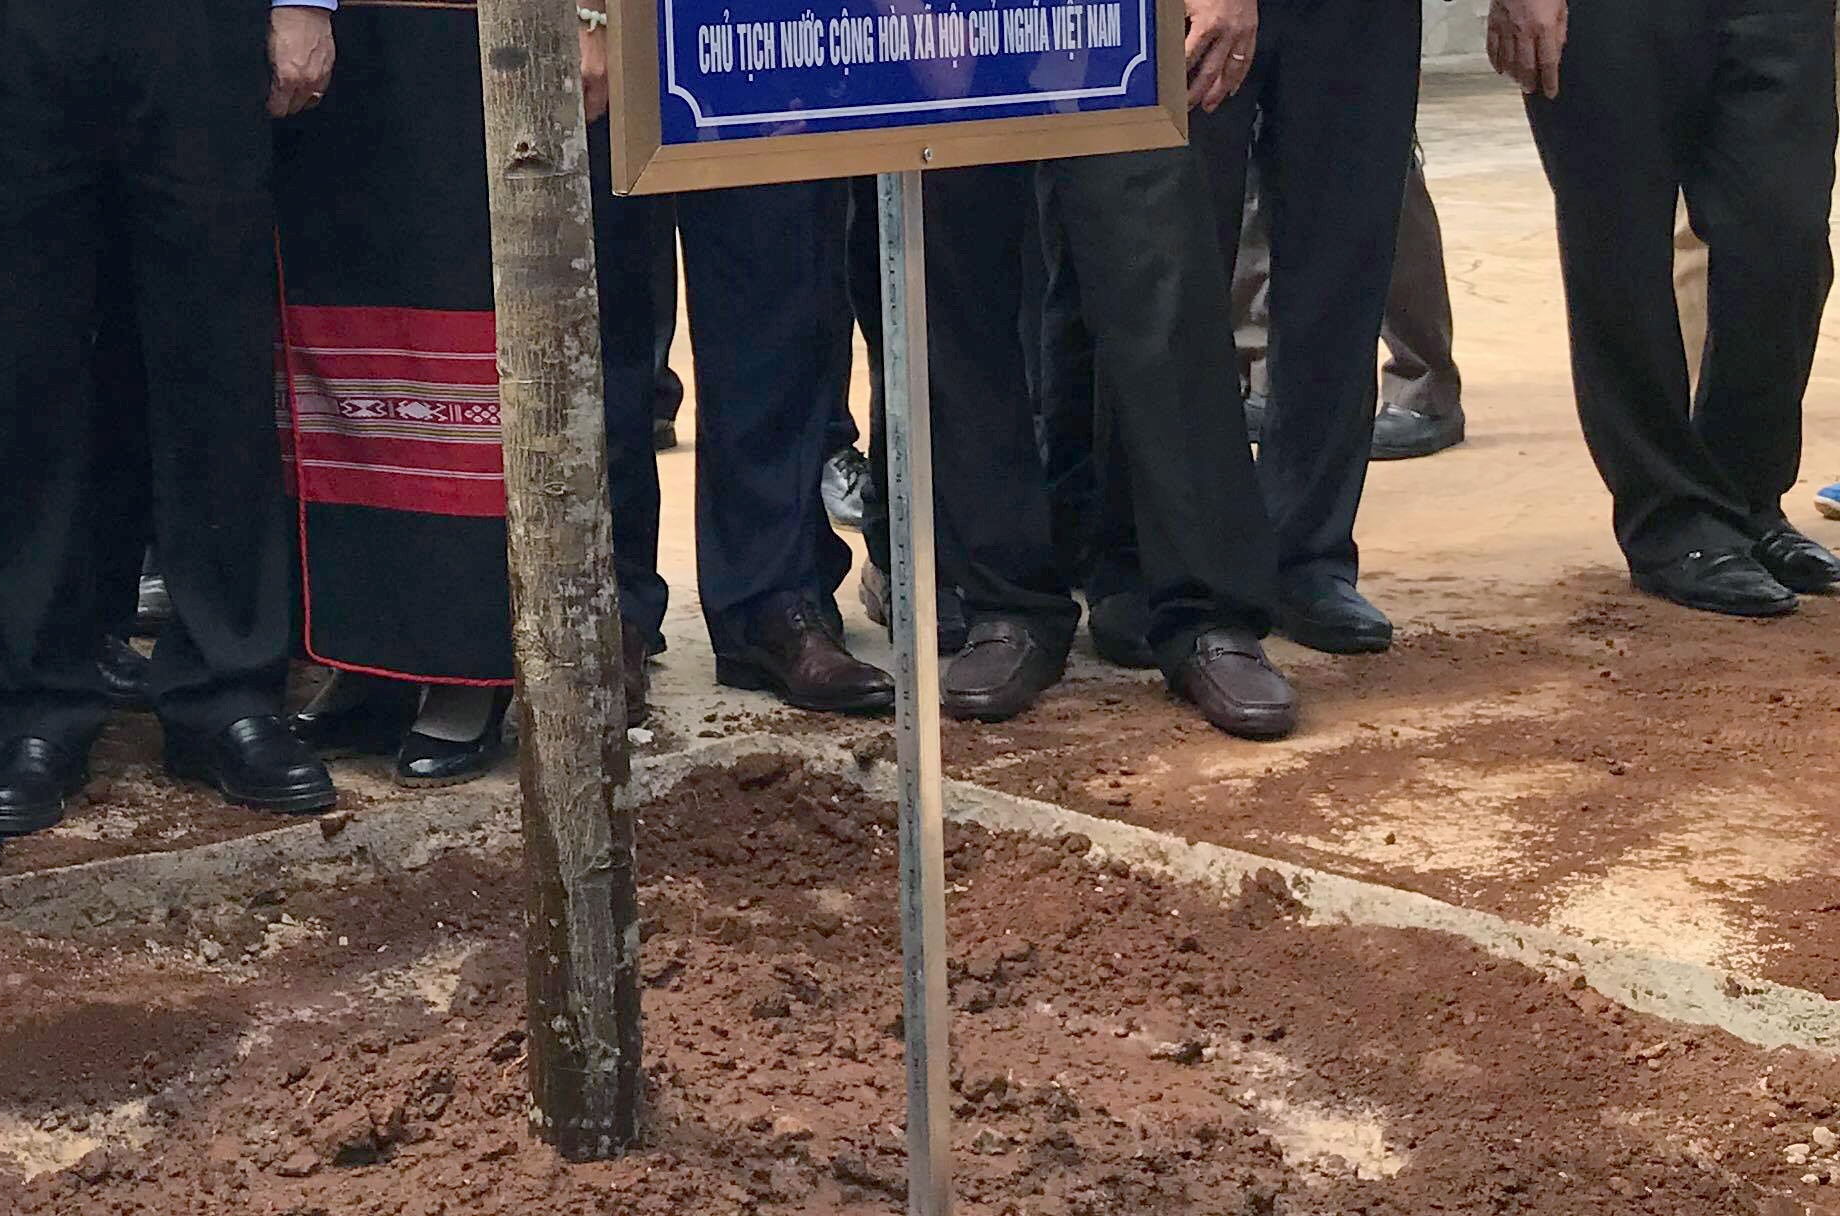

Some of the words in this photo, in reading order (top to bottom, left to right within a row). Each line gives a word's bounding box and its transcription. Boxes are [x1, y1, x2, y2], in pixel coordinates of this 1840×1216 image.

[698, 9, 734, 74] CHỦ
[736, 22, 776, 82] TỊCH
[780, 9, 825, 69] NƯỚC
[829, 7, 874, 76] CỘNG
[878, 5, 911, 62] HÒA
[912, 3, 936, 60] XÃ
[938, 2, 965, 69] HỘI
[1003, 0, 1050, 54] NGHĨA
[1087, 3, 1121, 49] NAM
